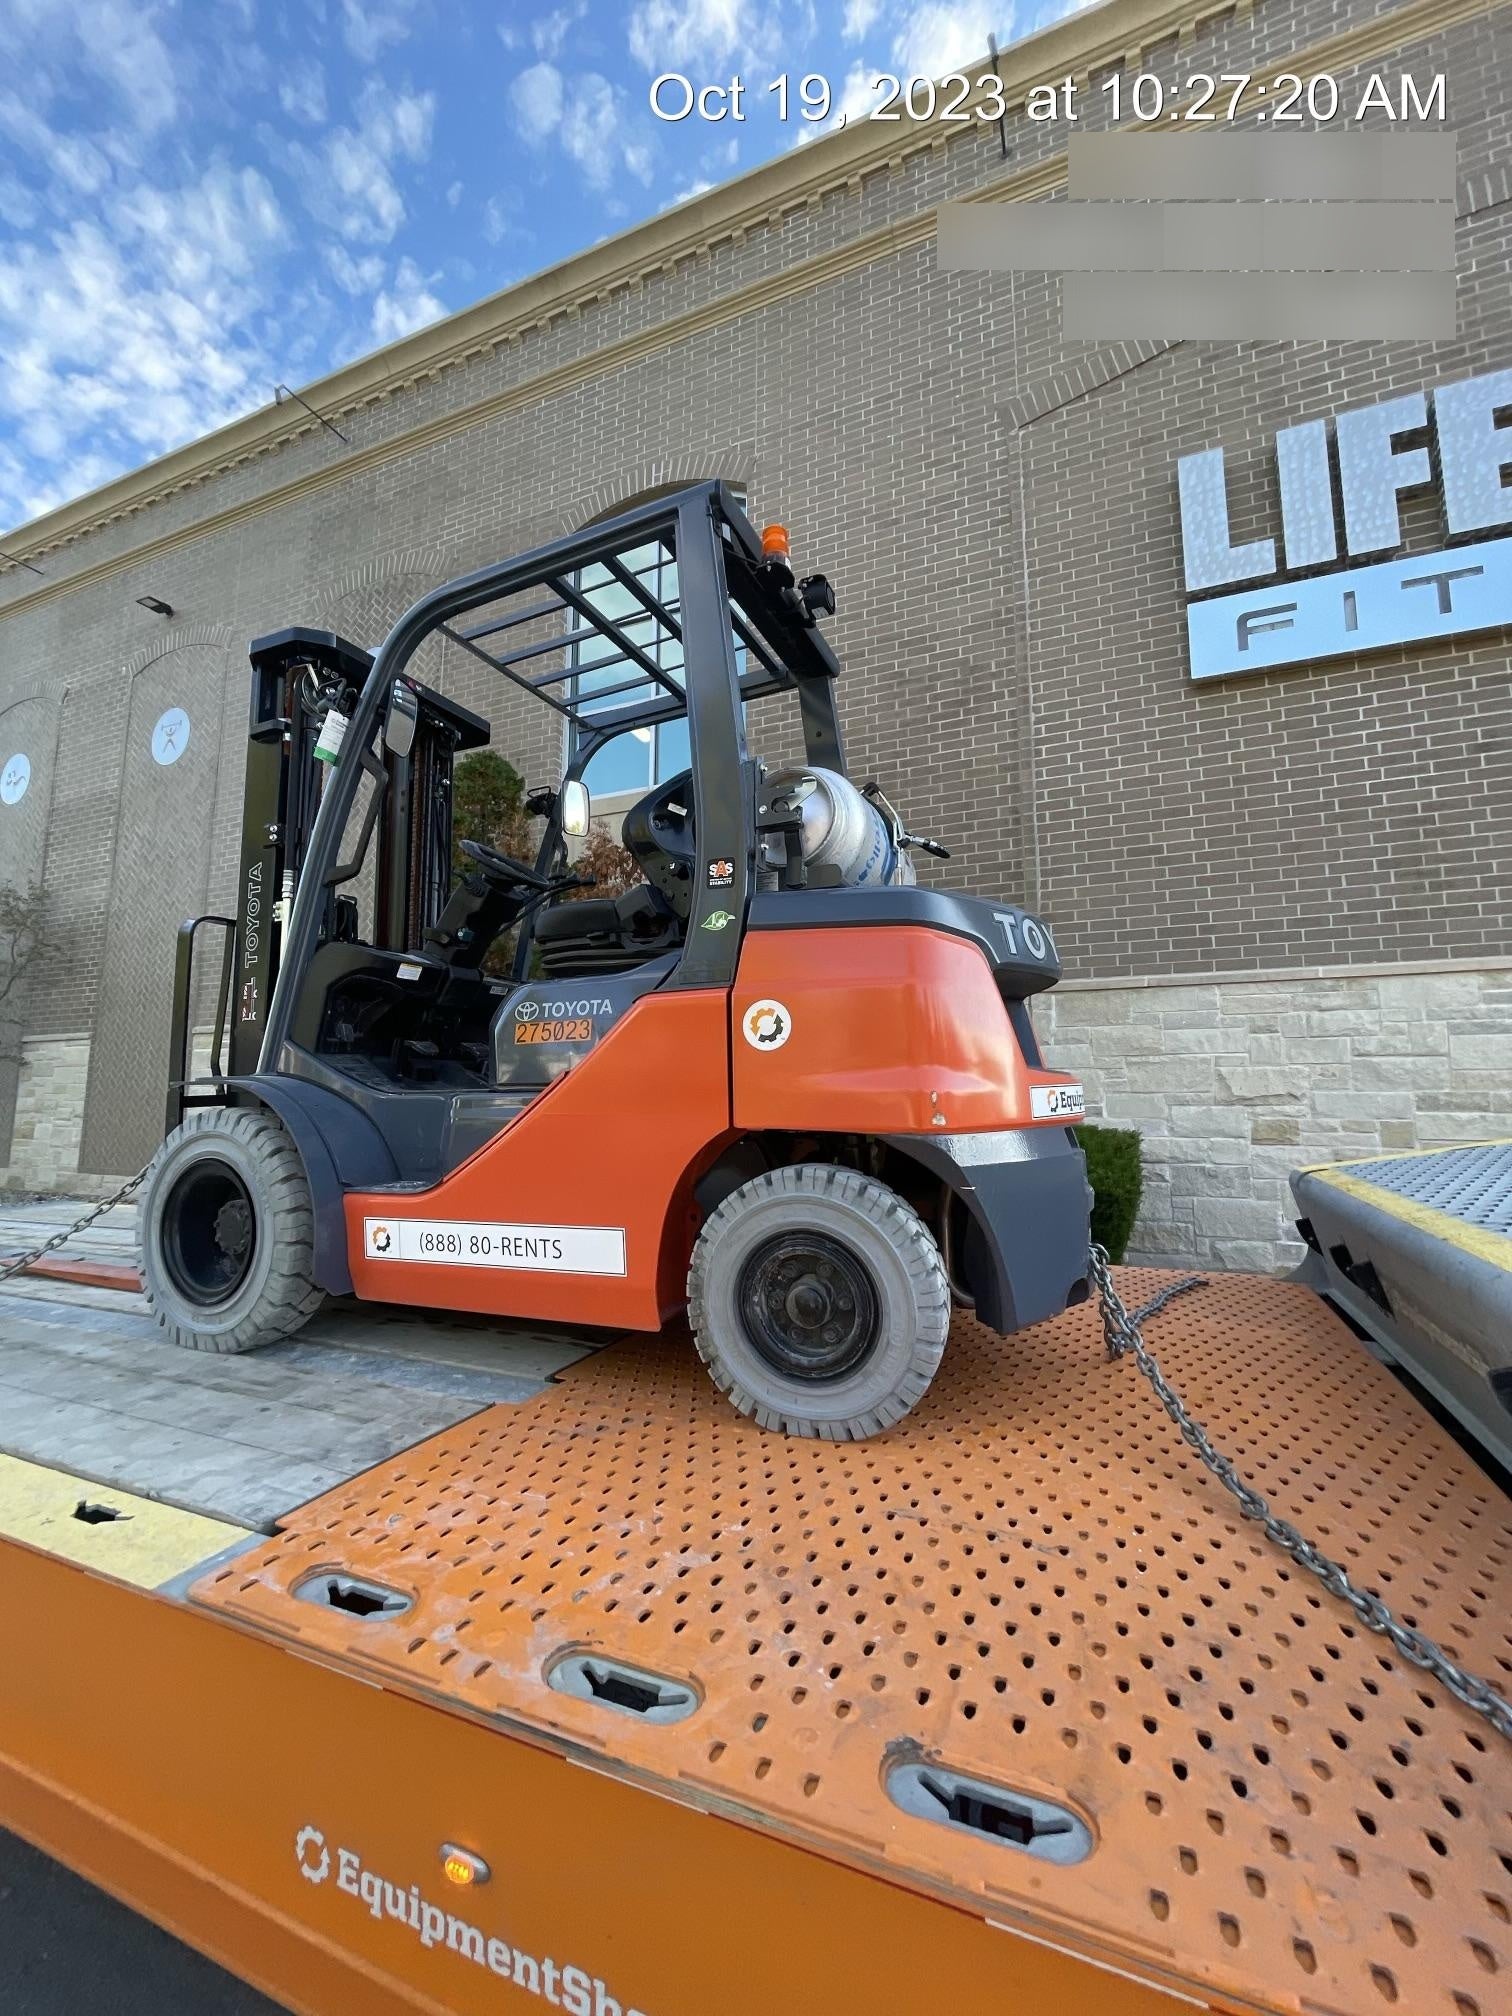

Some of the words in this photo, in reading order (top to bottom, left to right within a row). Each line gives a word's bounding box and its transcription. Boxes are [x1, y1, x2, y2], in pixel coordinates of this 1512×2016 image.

[1178, 366, 1512, 592] LIFE
[709, 860, 733, 877] SAS
[245, 861, 262, 969] TOYOTA
[542, 999, 613, 1018] TOYOTA
[516, 1020, 590, 1043] 275023
[419, 1232, 462, 1256] (888)
[469, 1235, 563, 1259] 80-RENTS
[337, 1848, 650, 2016] EquipmentSh
